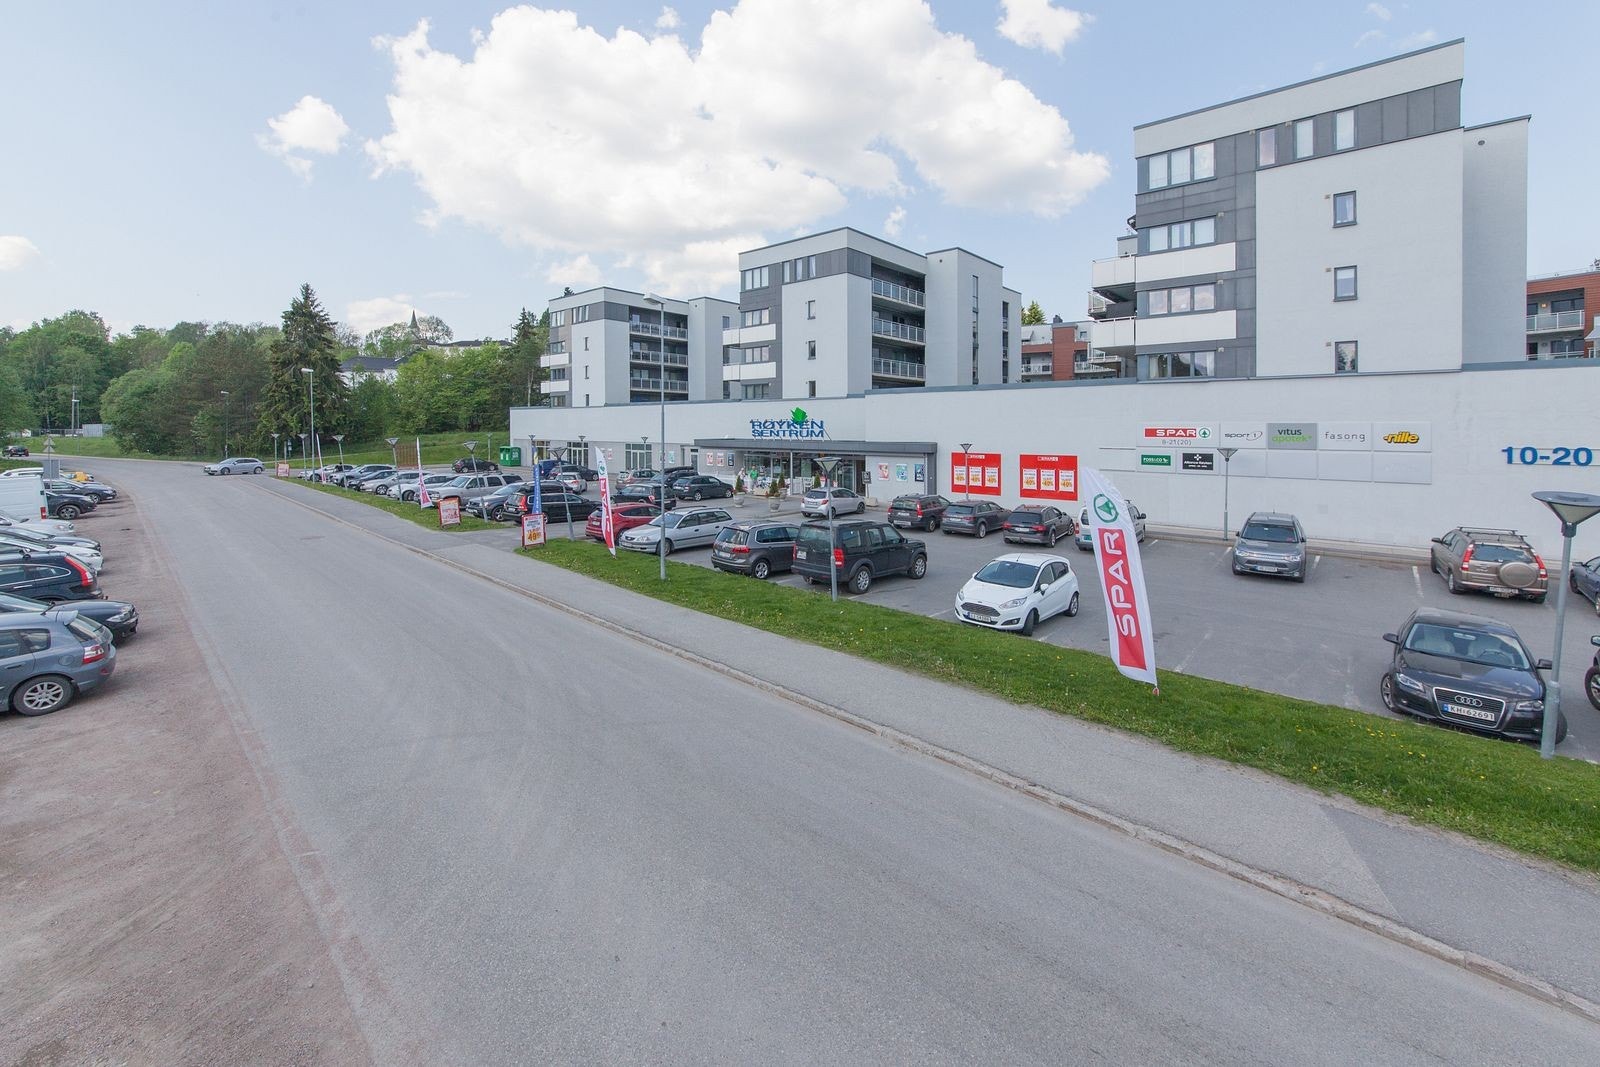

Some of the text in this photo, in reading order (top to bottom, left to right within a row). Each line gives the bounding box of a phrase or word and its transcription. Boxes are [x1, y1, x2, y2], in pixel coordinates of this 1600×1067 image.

[751, 419, 824, 430] RØYKEN
[751, 429, 824, 438] SENTRUM
[1156, 428, 1197, 437] SPAR
[1277, 427, 1303, 436] vitus
[1324, 431, 1366, 443] fasong
[1271, 434, 1309, 444] apotek
[1386, 431, 1420, 444] nille
[1501, 446, 1593, 467] 10-20
[1103, 531, 1137, 638] SPAR
[1450, 705, 1494, 720] KH 62691
